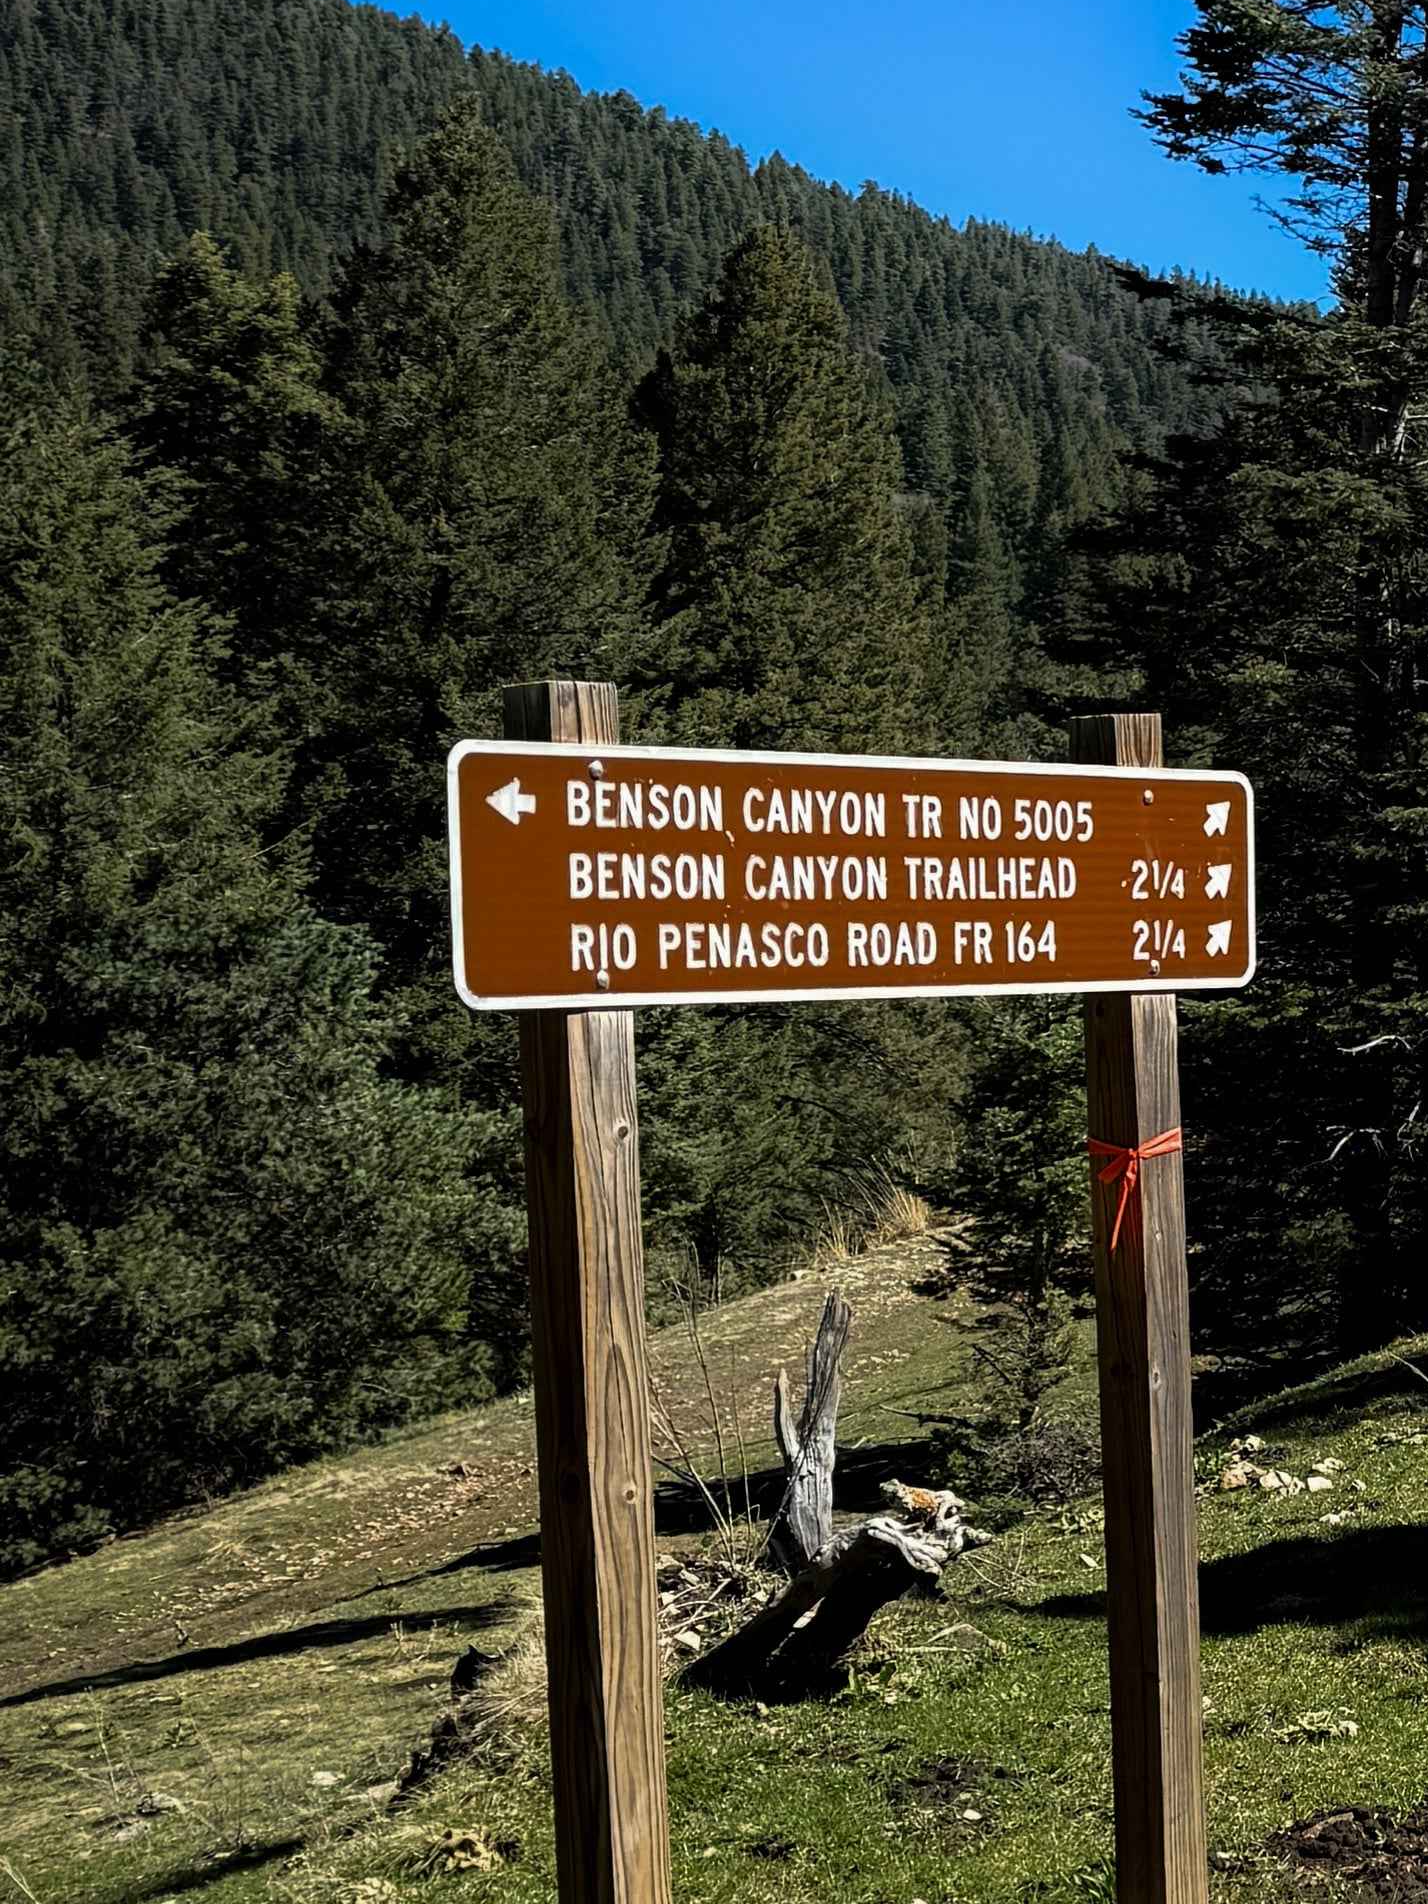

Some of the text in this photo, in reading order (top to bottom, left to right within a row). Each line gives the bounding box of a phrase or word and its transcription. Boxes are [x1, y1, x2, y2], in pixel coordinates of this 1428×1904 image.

[566, 780, 1094, 842] BENSON CANYON TR NO 5005
[569, 852, 725, 900] BENSON
[745, 854, 888, 901] CANYON
[904, 856, 1077, 900] TRAILHEAD
[571, 923, 637, 970] RIO
[658, 921, 830, 970] PENASCO
[847, 921, 937, 967] ROAD
[954, 921, 993, 965] FR
[1005, 920, 1057, 963] 164
